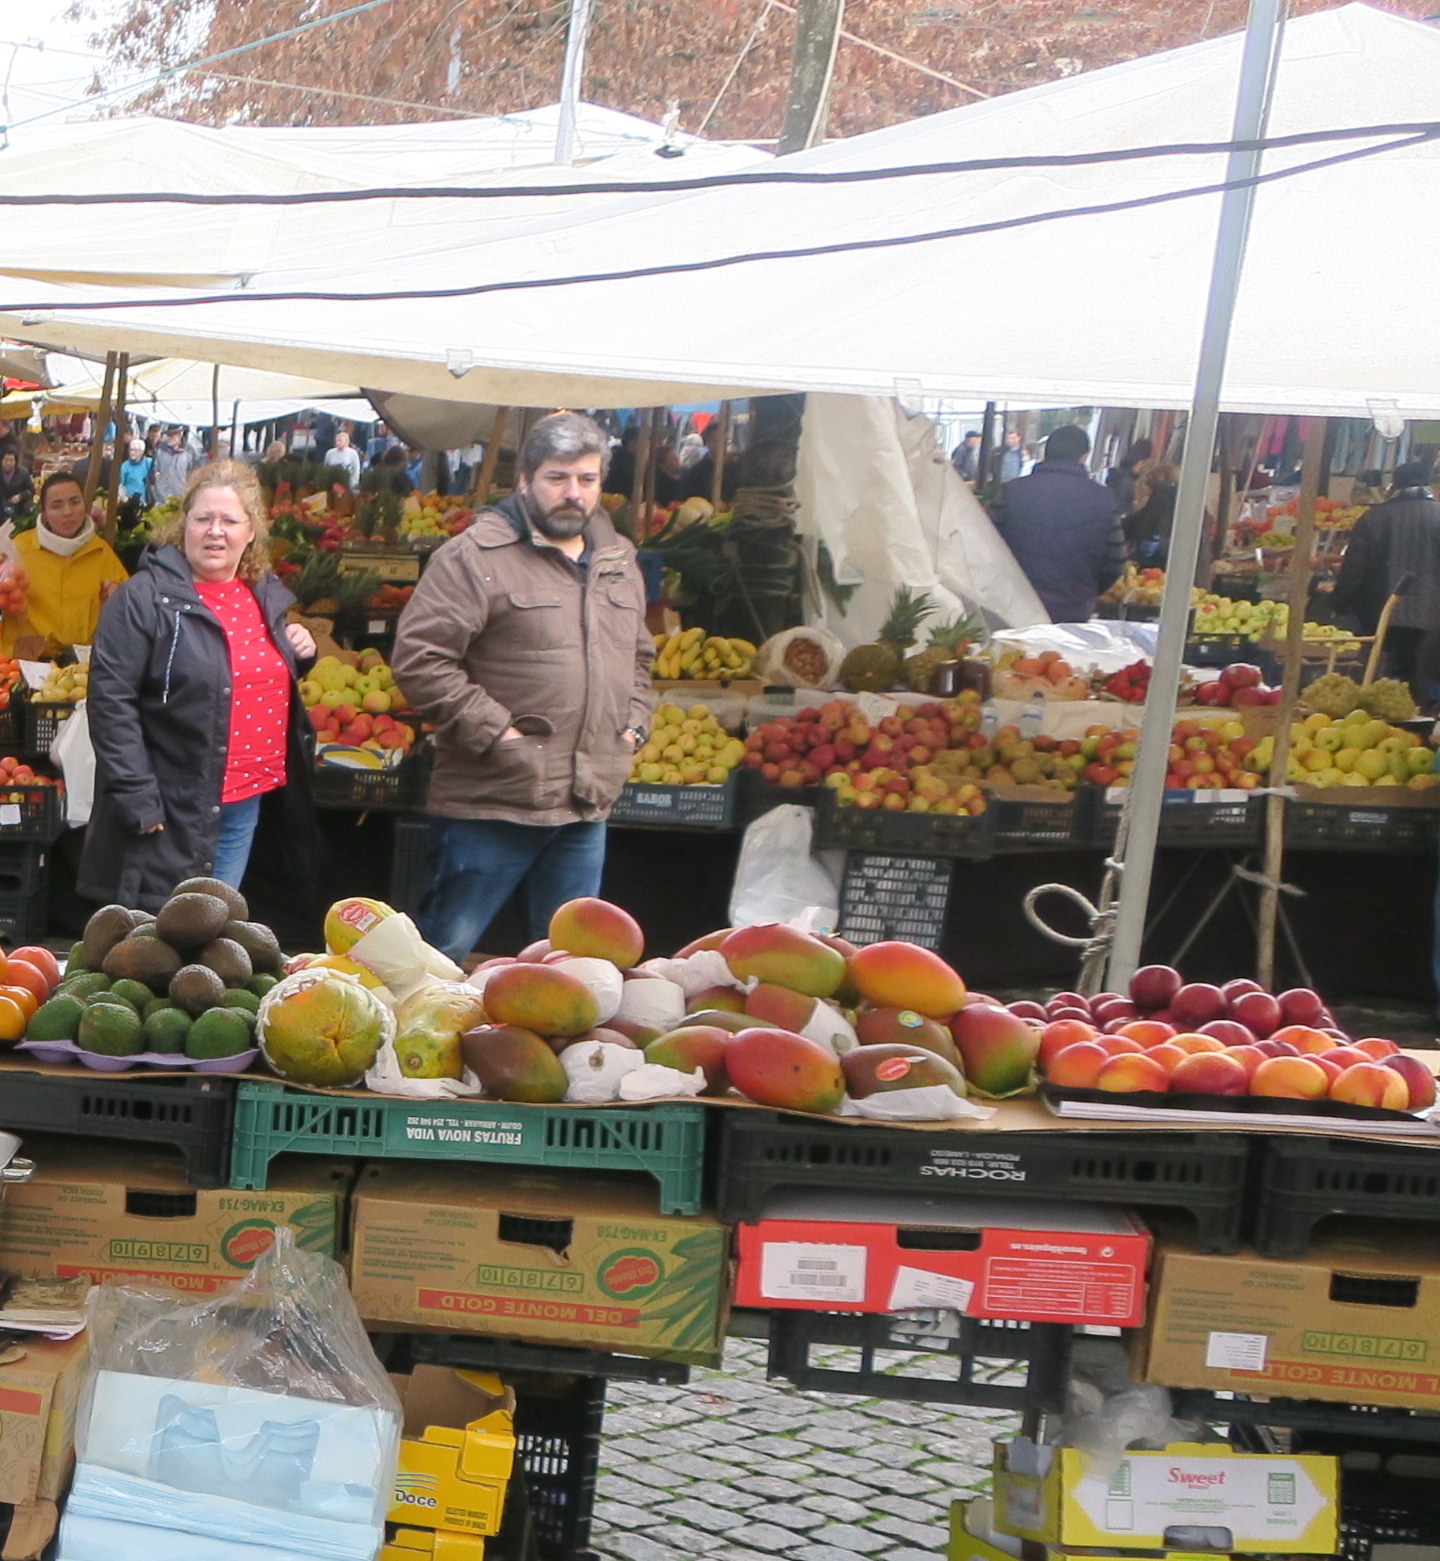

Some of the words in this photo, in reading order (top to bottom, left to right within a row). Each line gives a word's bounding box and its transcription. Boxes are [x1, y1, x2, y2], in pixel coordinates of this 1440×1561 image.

[406, 1128, 435, 1140] VIDA
[438, 1129, 471, 1142] NOVA
[474, 1130, 522, 1145] FRUTAS
[919, 1165, 1026, 1181] ROCHAS
[219, 1198, 285, 1213] EX-MAG-758
[597, 1225, 668, 1241] EX-MAG-758
[114, 1243, 130, 1254] 10
[139, 1245, 147, 1255] 9
[157, 1247, 166, 1257] 8
[176, 1248, 184, 1258] 7
[193, 1249, 203, 1259] 6
[482, 1269, 500, 1282] 10
[507, 1272, 517, 1283] 9
[528, 1274, 538, 1285] 8
[547, 1275, 557, 1286] 7
[567, 1276, 576, 1287] 6
[440, 1295, 497, 1313] GOLD
[503, 1302, 577, 1319] MONTE
[583, 1308, 622, 1323] DEL
[1308, 1335, 1327, 1349] 10
[1338, 1339, 1349, 1351] 9
[1362, 1341, 1372, 1354] 8
[1386, 1343, 1395, 1355] 7
[1408, 1344, 1418, 1357] 6
[1330, 1370, 1418, 1389] MONTE
[1167, 1468, 1226, 1485] Sweet
[394, 1489, 437, 1507] Doce
